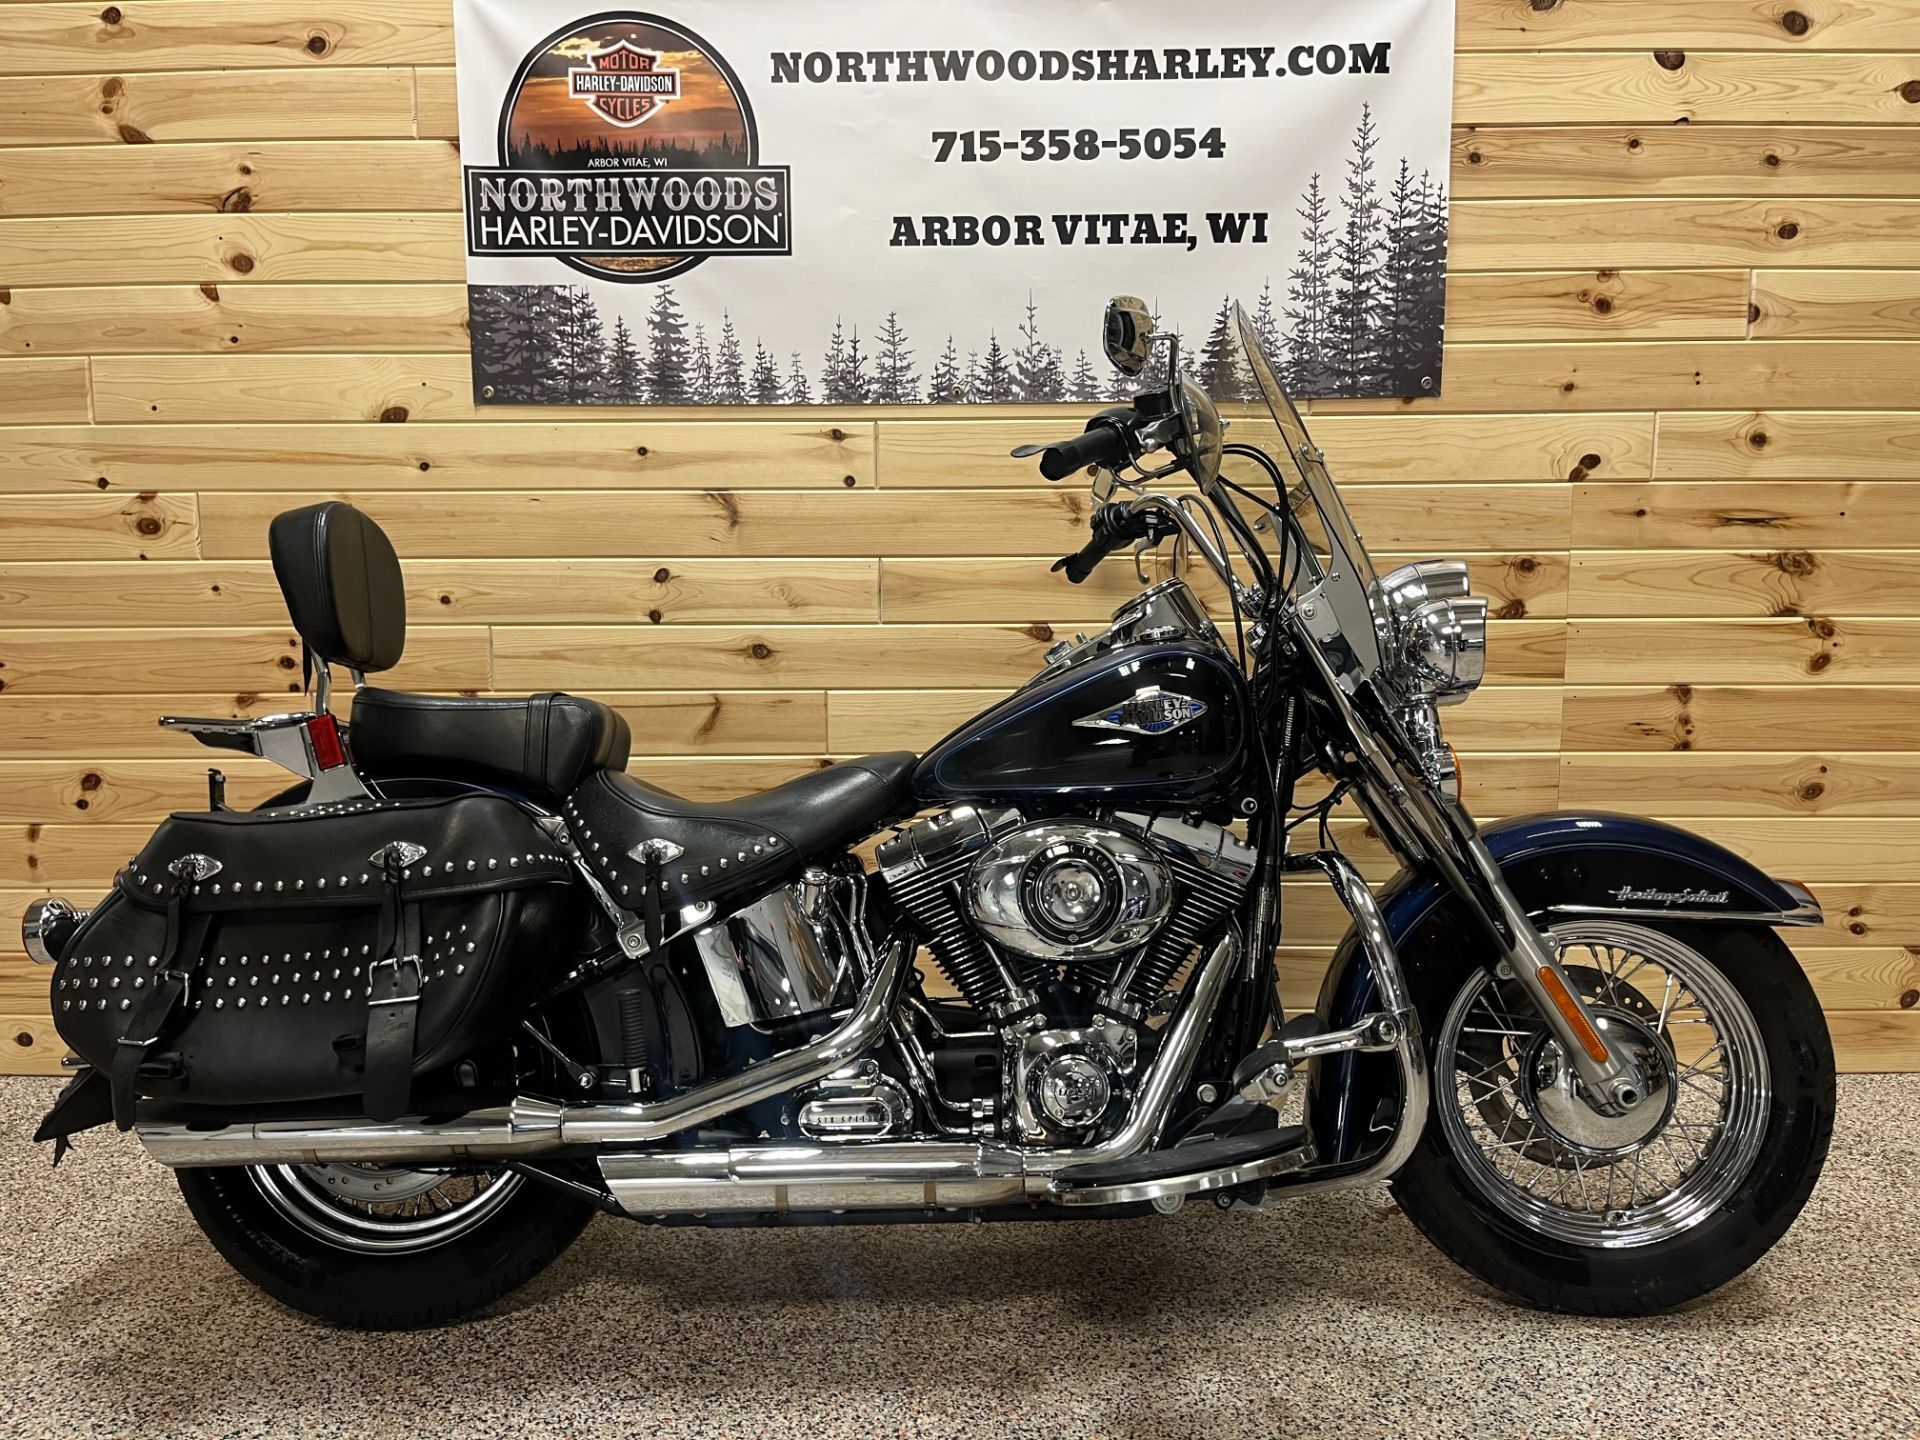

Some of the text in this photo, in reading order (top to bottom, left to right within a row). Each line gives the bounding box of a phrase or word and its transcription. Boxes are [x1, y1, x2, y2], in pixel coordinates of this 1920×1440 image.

[600, 49, 650, 70] MOTOR
[770, 42, 1391, 83] NORTHWOODSHARLEY.COM
[576, 75, 673, 92] HARLEY-DAVIDSON
[600, 98, 651, 120] CYCLES
[931, 127, 1226, 162] 715-358-5054
[587, 157, 668, 169] ARBOR VITAE, WI
[479, 177, 777, 212] NORTHWOODS
[481, 214, 780, 247] HARLEY-DAVIDSON
[889, 211, 1268, 251] ARBOR VITAE, WI
